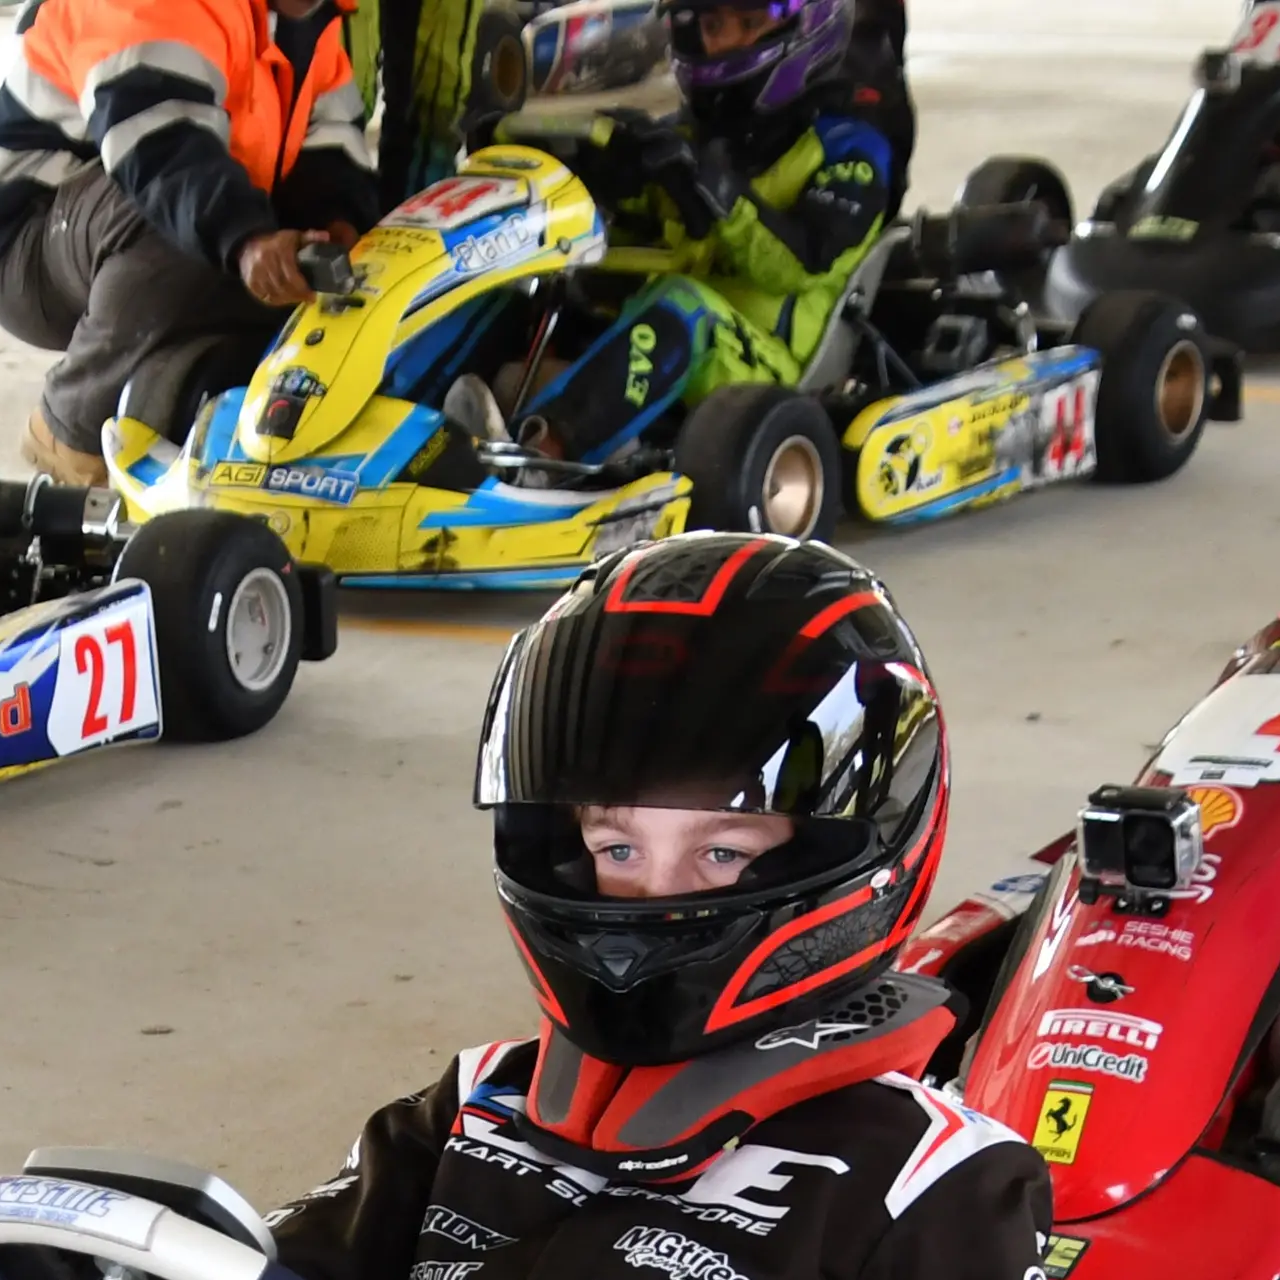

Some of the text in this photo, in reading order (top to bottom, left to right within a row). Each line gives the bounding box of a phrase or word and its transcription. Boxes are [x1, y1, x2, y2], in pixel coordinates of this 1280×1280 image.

[268, 469, 354, 498] SPORT
[73, 616, 140, 740] 27
[1116, 934, 1194, 962] RACING
[1037, 1008, 1163, 1051] PIRELLI
[1050, 1044, 1147, 1080] UniCredit
[443, 1136, 543, 1176] KART
